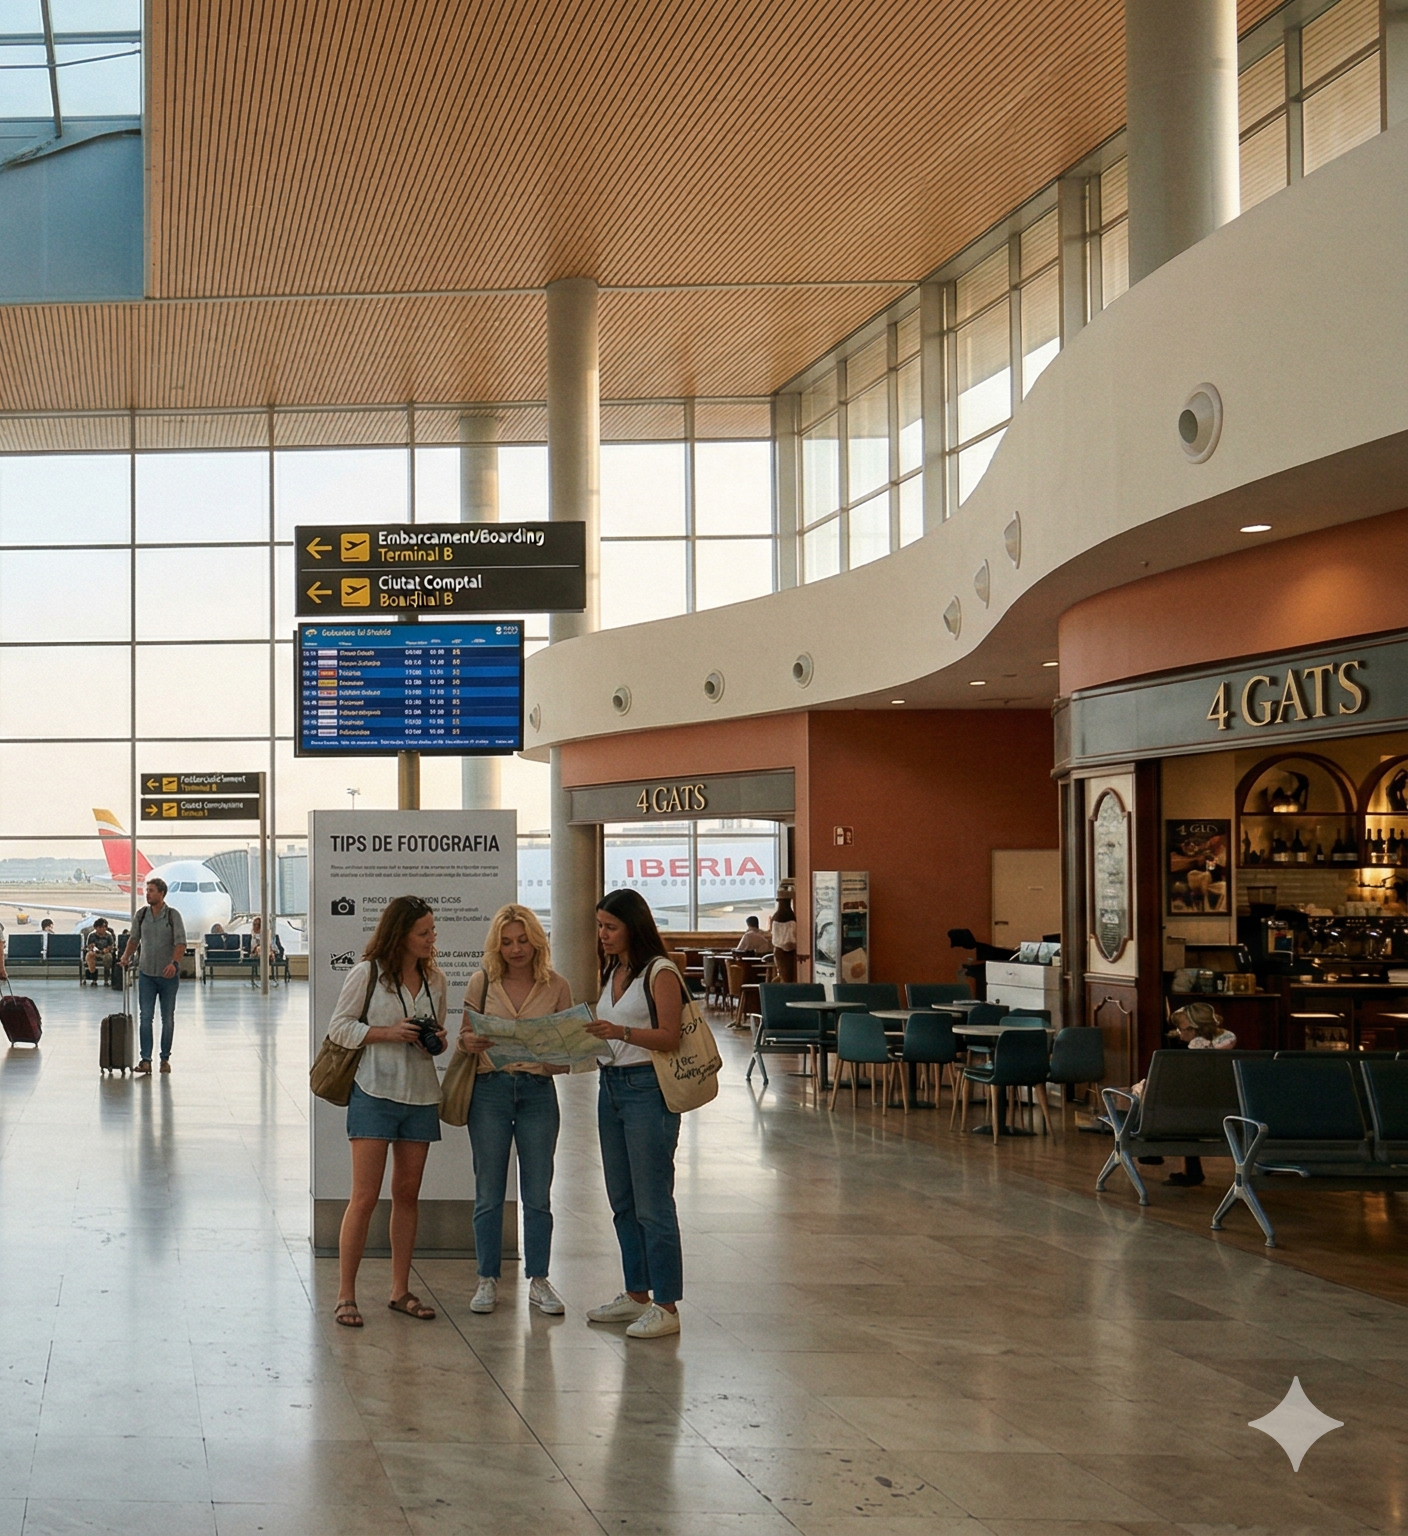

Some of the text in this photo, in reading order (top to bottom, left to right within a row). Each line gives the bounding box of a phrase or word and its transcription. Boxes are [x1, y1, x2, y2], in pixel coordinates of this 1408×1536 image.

[378, 546, 454, 562] Terminal B
[378, 574, 482, 593] Ciutat Comptal
[444, 592, 454, 606] B
[1206, 660, 1363, 731] 4 GATS
[636, 784, 706, 813] 4 GATS
[330, 834, 500, 852] TIPS DE FOTOGRAFIA
[626, 856, 765, 878] IBERIA
